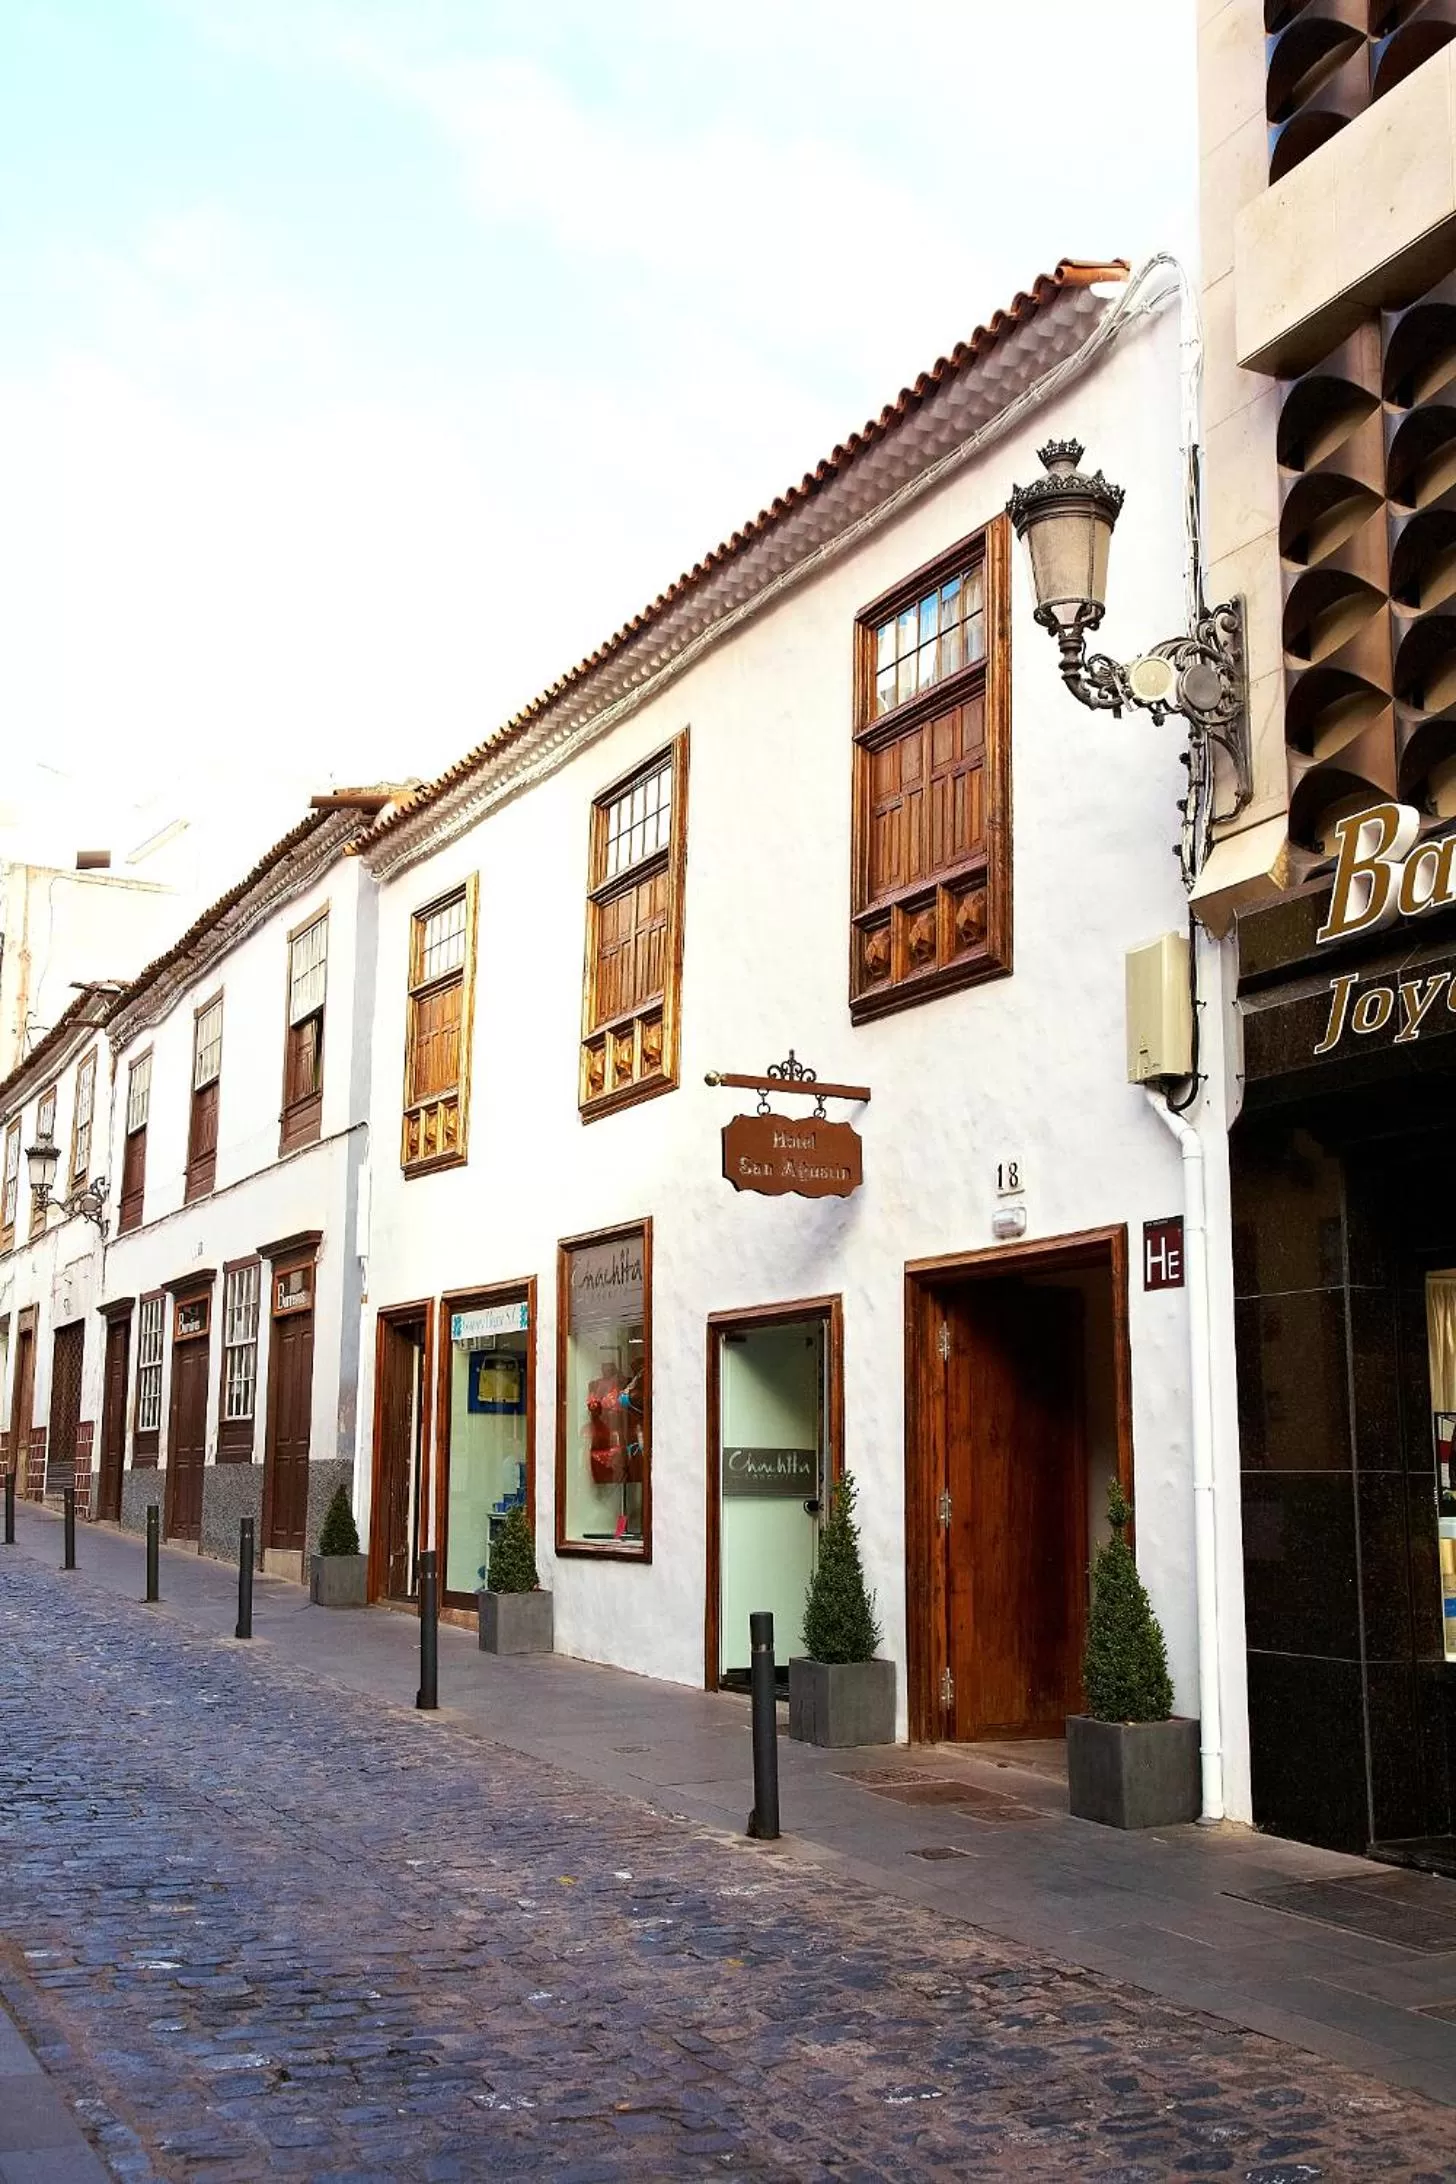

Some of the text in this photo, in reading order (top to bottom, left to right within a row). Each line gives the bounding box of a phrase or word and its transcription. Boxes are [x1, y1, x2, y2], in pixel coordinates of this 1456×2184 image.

[1313, 972, 1456, 1055] Joy
[738, 1156, 774, 1177] San
[997, 1162, 1019, 1190] 18
